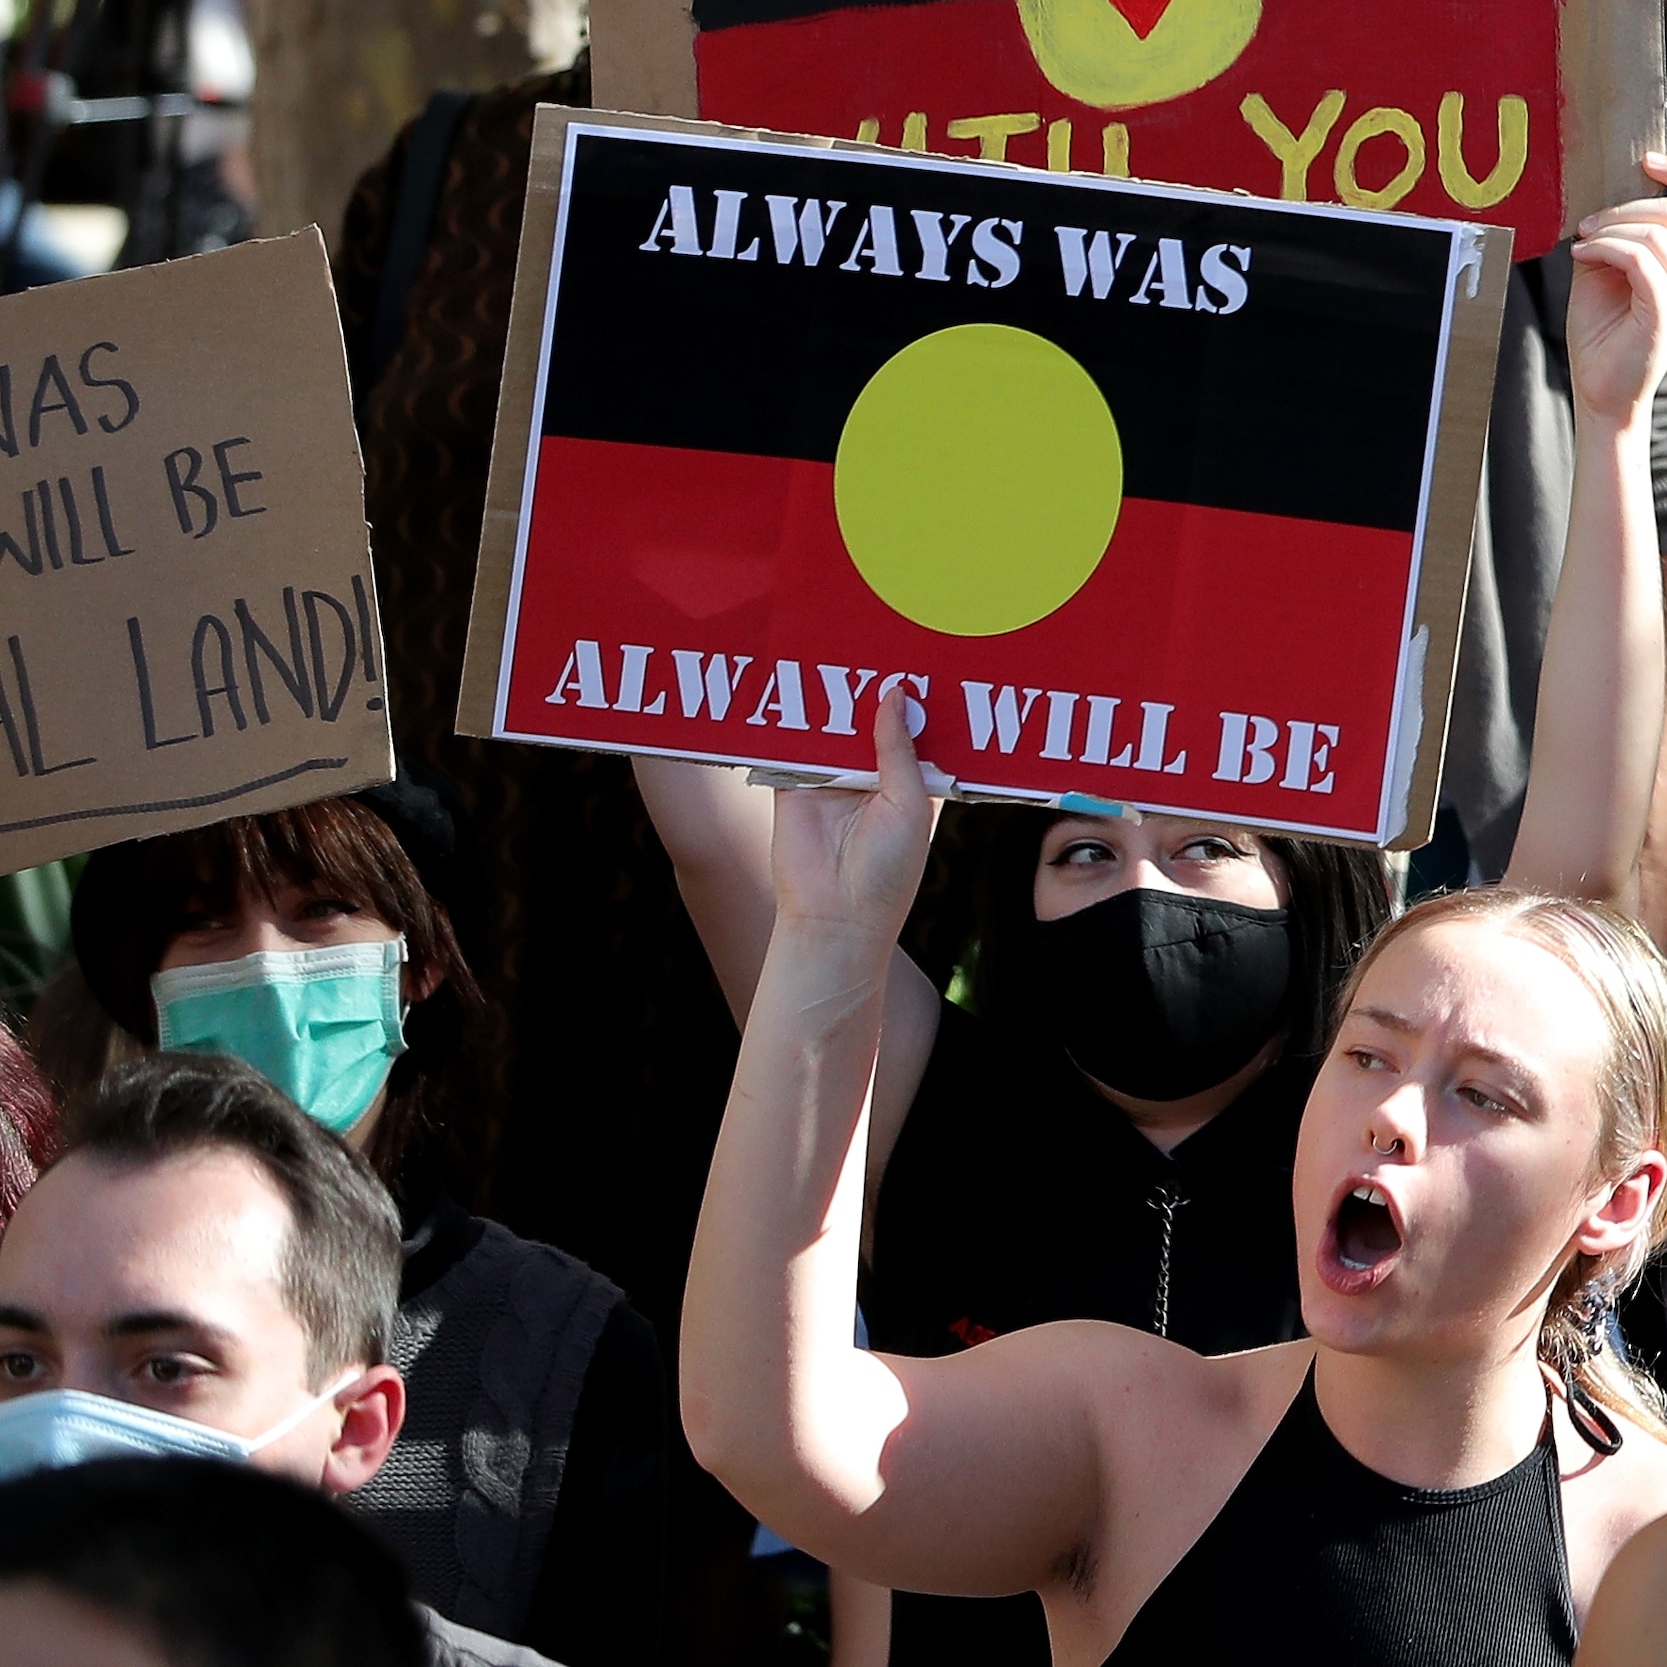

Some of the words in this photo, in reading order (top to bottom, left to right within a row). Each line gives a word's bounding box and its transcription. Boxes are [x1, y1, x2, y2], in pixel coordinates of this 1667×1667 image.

[1238, 90, 1529, 210] YOU
[640, 185, 1023, 289] ALWAYS
[1053, 224, 1253, 316] WAS
[164, 436, 267, 540] BE
[127, 574, 385, 751] LAND!
[545, 639, 931, 740] ALWAYS
[959, 679, 1188, 775] WILL
[1216, 710, 1341, 794] BE
